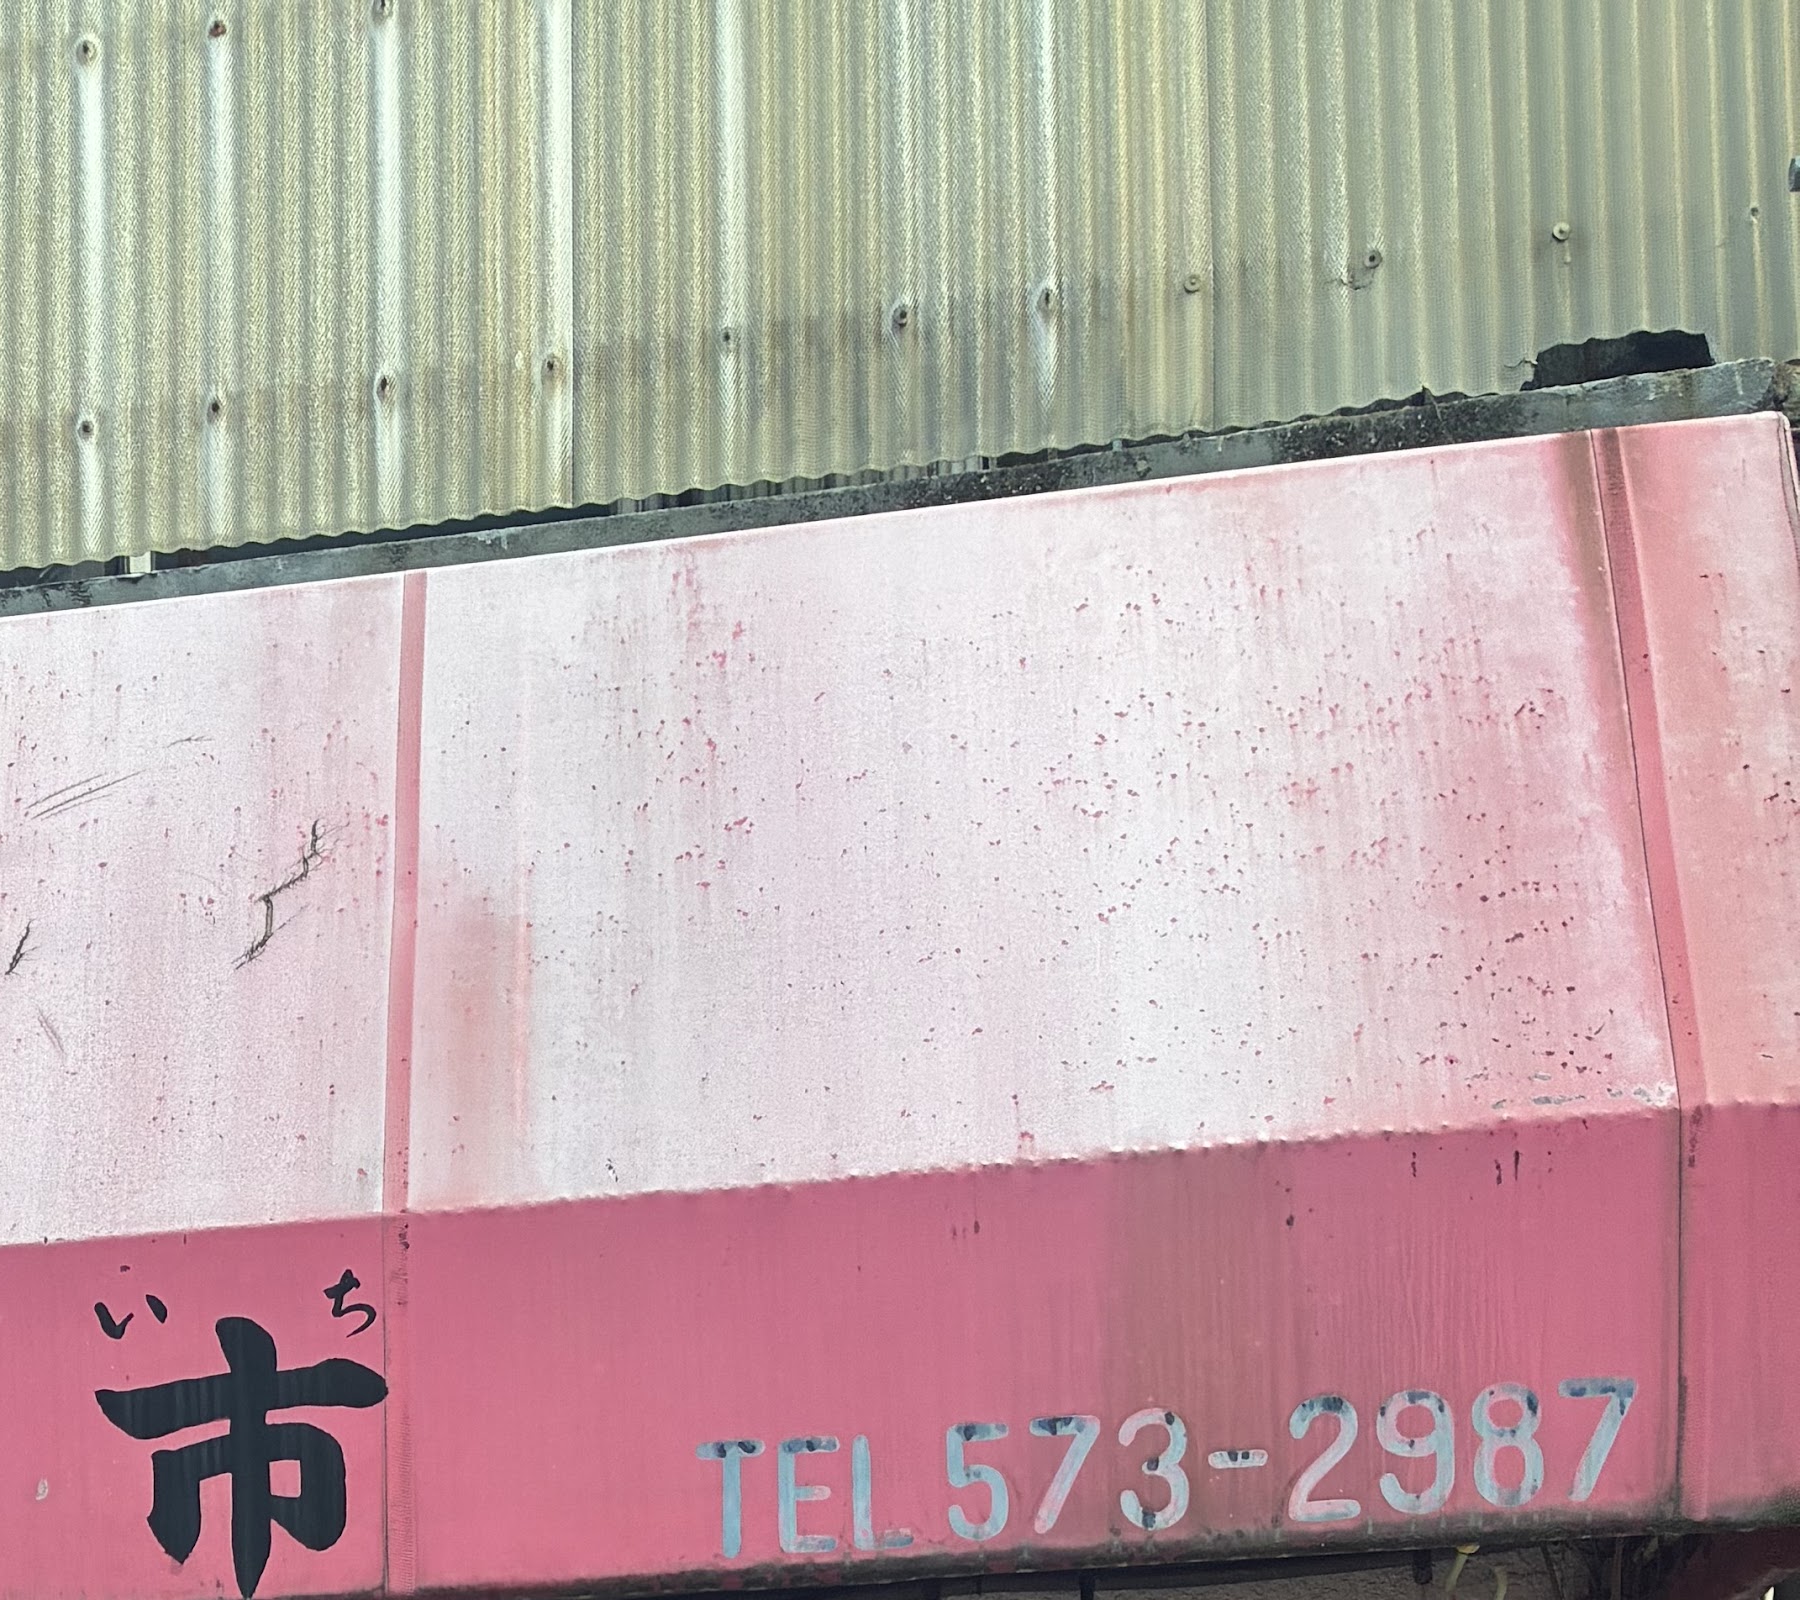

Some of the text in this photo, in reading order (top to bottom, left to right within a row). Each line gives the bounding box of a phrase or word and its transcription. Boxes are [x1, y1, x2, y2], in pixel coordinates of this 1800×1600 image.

[95, 1316, 389, 1600] 市
[697, 1376, 1638, 1559] TEL 573-2987
